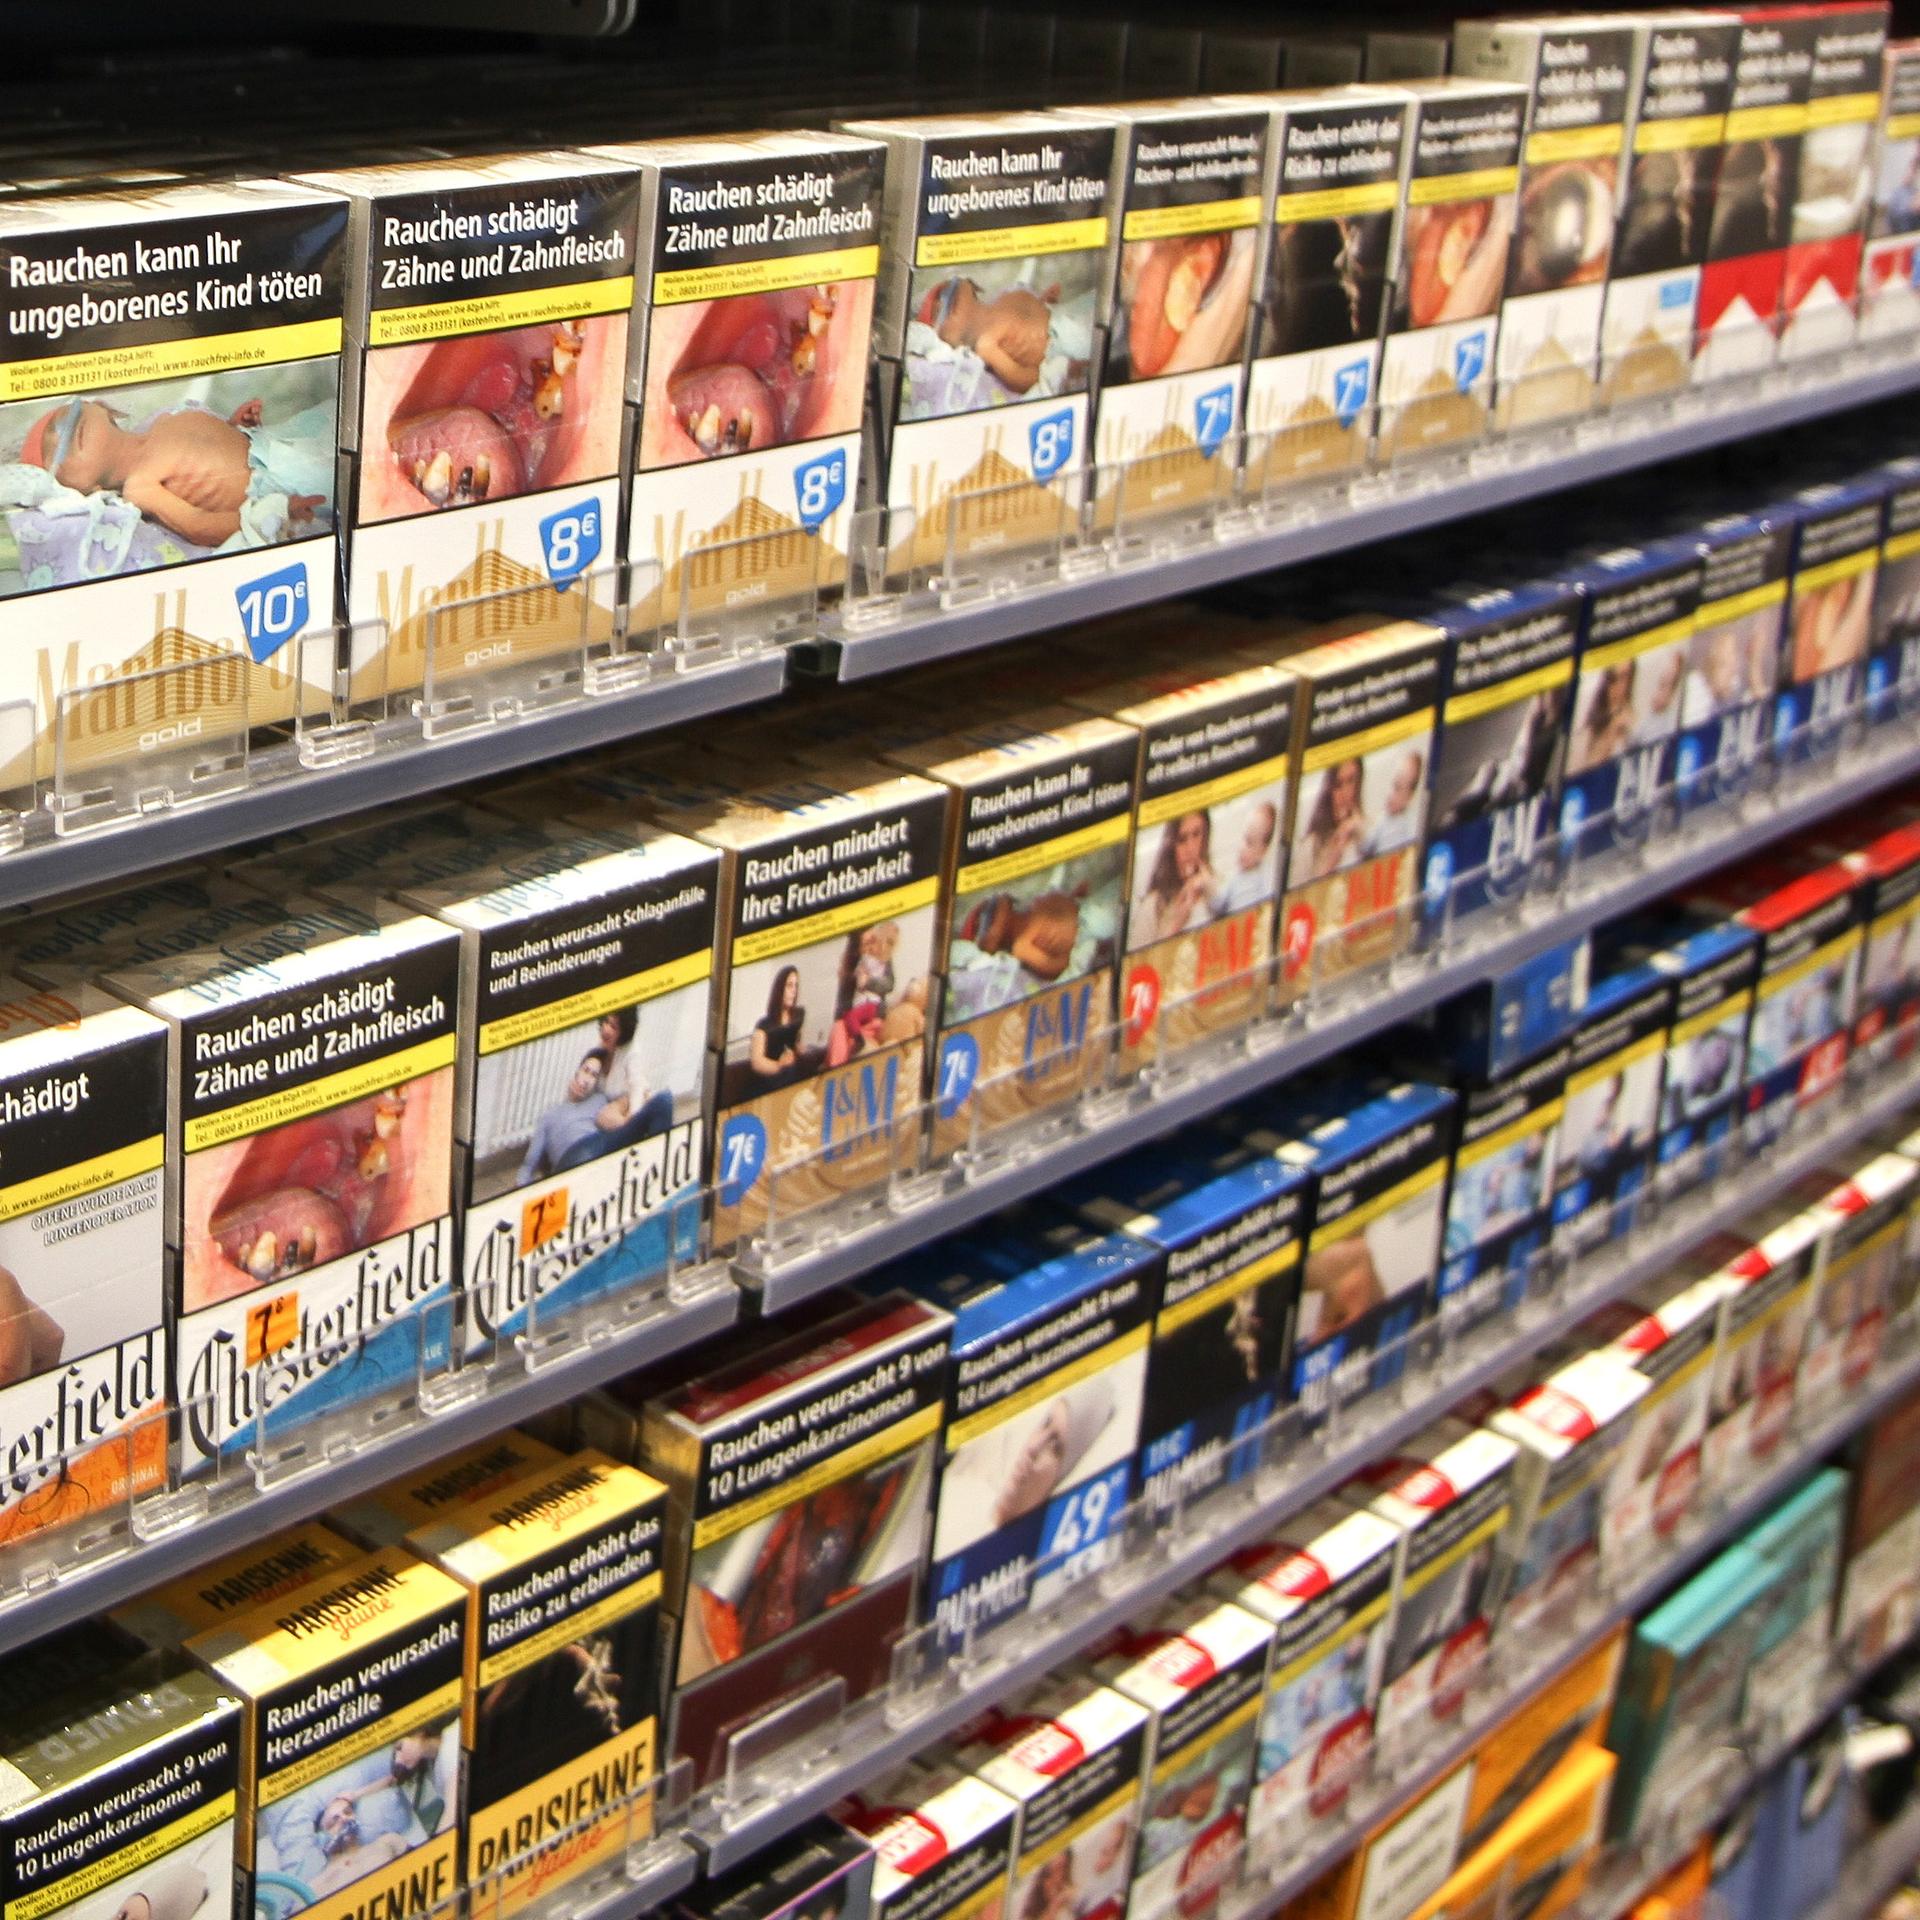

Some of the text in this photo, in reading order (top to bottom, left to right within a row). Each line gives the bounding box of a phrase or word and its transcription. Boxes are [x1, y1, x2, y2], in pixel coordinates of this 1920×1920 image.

[669, 171, 834, 214] Rauchen schädigt
[931, 145, 1063, 180] Rauchen kann Ihr
[384, 198, 580, 248] Rauchen schädigt
[664, 201, 873, 253] Zähne und Zahnfleisch
[927, 176, 1106, 219] ungeborenes Kind töten
[10, 231, 242, 288] Rauchen kann Ihr
[381, 229, 626, 289] Zähne und Zahnfleisch
[9, 271, 323, 339] ungeborenes Kind töten
[10, 364, 40, 377] Wollen
[33, 377, 59, 391] 0800
[60, 375, 67, 386] 8
[68, 371, 102, 386] 313131
[163, 347, 267, 373] www.rauchfrei-info.de
[1035, 420, 1070, 469] 8€
[800, 461, 843, 516] 8€
[548, 511, 597, 571] 8€
[239, 580, 306, 639] 10€
[377, 518, 596, 656] Marlbor
[36, 587, 297, 744] Marlboo
[463, 639, 513, 667] gold
[138, 717, 203, 750] gold
[967, 803, 1060, 850] ungeborenes
[1062, 787, 1093, 818] Kind
[970, 762, 1091, 821] Rauchen kann Ihr
[745, 817, 909, 888] Rauchen mindert
[742, 850, 912, 924] Ihre Fruchtbarkeit
[490, 885, 706, 970] Rauchen verursacht Schlaganfälle
[489, 939, 622, 995] und Behinderungen
[193, 1055, 269, 1100] Zähne
[274, 1035, 319, 1076] und
[323, 995, 446, 1060] Zahnfleisch
[195, 976, 397, 1062] Rauchen schädigt
[0, 1072, 90, 1126] hädigt
[0, 1331, 156, 1511] erfield
[709, 1341, 948, 1470] Rauchen verursacht 9 von
[708, 1387, 917, 1502] 10 Lungenkarzinomen
[111, 1464, 161, 1496] ORGINAL
[490, 1464, 609, 1531] PARISIENNE
[199, 1539, 336, 1612] PARISIENNE
[487, 1605, 543, 1646] Risiko
[545, 1592, 567, 1617] zu
[570, 1548, 653, 1604] erblinden
[488, 1516, 660, 1616] Rauchen erhöht das
[276, 1563, 407, 1641] PARISIENNE
[266, 1676, 355, 1733] Rauchen
[358, 1619, 460, 1687] verursacht
[266, 1691, 383, 1763] Herzanfälle
[14, 1812, 90, 1858] Rauchen
[94, 1765, 182, 1819] verursacht
[184, 1754, 196, 1776] 9
[198, 1740, 228, 1768] von
[15, 1778, 202, 1882] 10 Lungenkarzinomen
[478, 1739, 649, 1899] PARISIENNE
